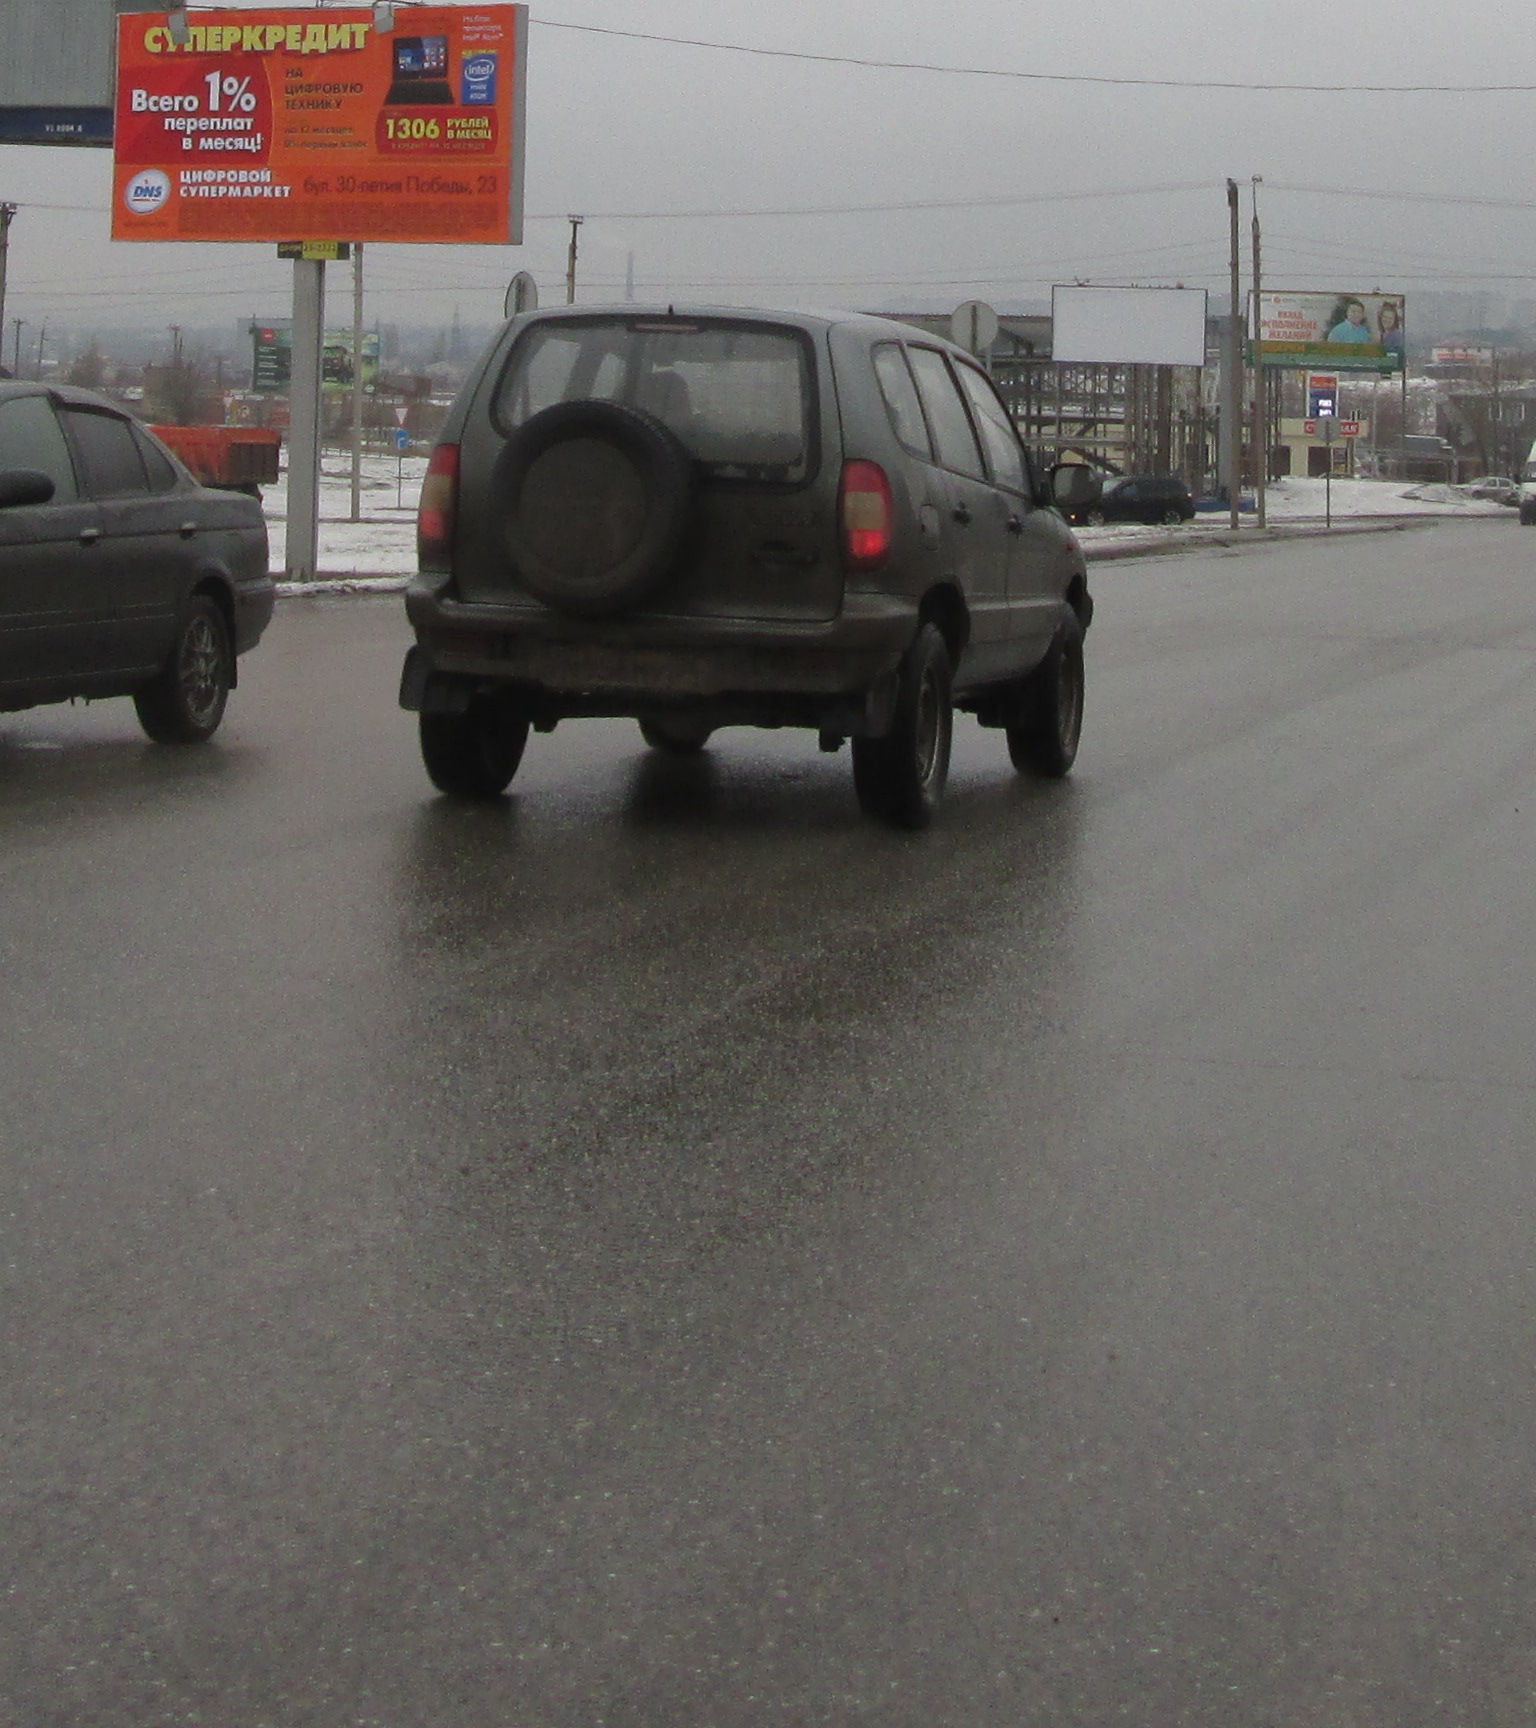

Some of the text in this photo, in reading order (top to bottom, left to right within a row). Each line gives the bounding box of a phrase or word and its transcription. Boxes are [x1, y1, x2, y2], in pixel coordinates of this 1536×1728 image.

[285, 68, 303, 78] НА
[468, 64, 490, 75] intel
[132, 70, 257, 112] Всего 1%
[285, 82, 364, 96] ЦИФРОВУЮ
[285, 99, 343, 110] ТЕХНИКУ
[164, 116, 254, 134] переплат
[386, 117, 440, 140] 1306
[447, 116, 489, 128] РУБЛЕЙ
[447, 129, 492, 141] В МЕСЯЦ
[182, 133, 262, 152] в месяц!
[179, 168, 272, 184] ЦИФРОВОЙ
[477, 175, 498, 194] 23
[133, 185, 163, 198] DNS
[179, 185, 291, 198] СУПЕРМАРКЕТ
